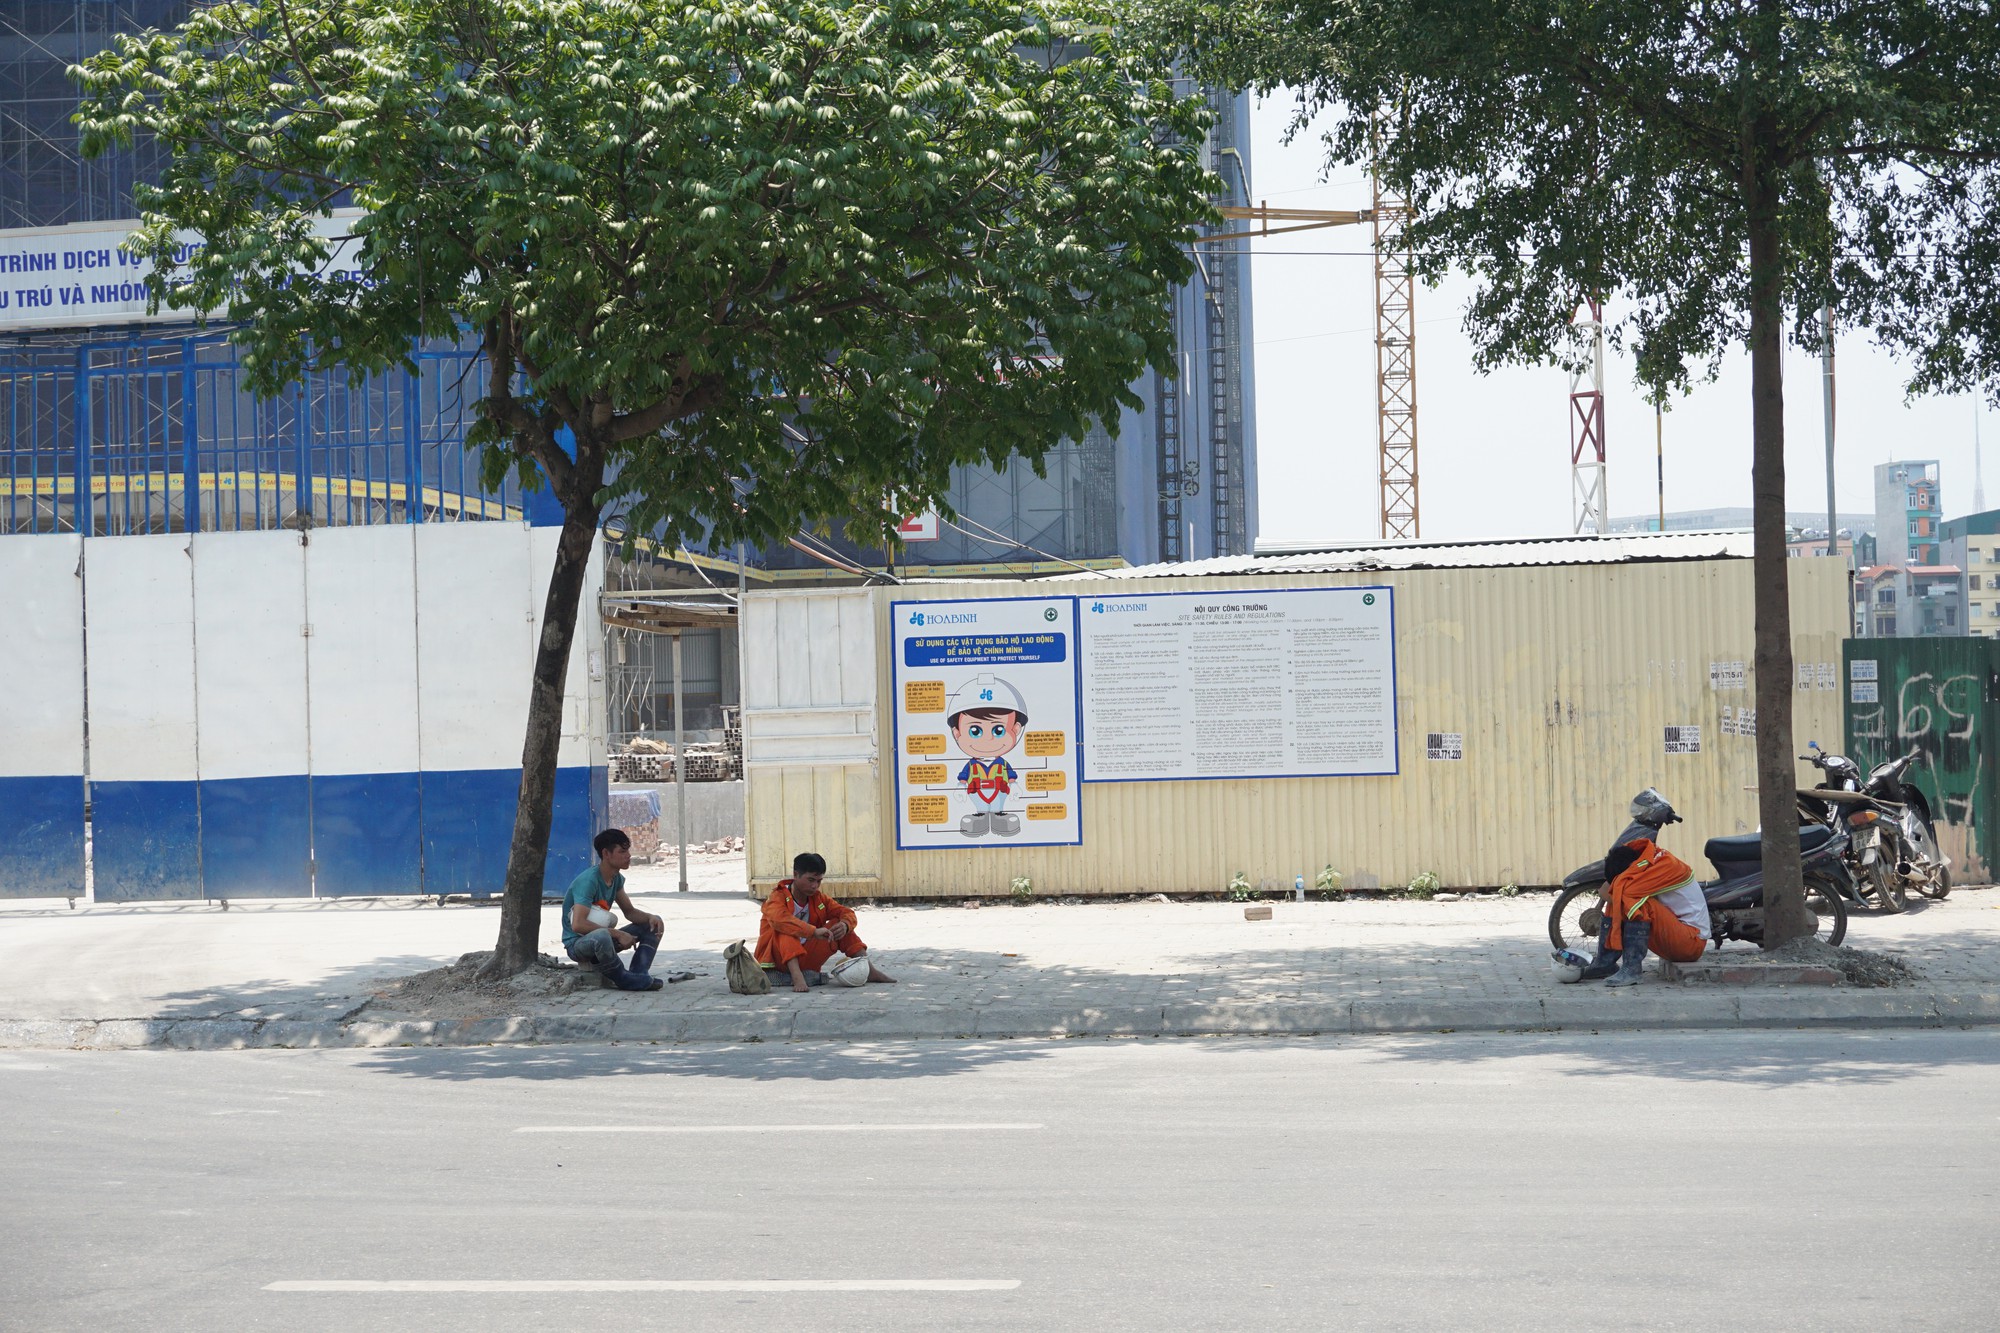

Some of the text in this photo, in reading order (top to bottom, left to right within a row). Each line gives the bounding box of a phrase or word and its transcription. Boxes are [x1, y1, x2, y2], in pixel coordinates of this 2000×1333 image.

[0, 251, 56, 273] TRÌNH
[64, 249, 110, 273] DỊCH
[116, 248, 142, 270] VỤ
[16, 285, 52, 308] TRÚ
[60, 283, 84, 305] VÀ
[92, 280, 150, 304] NHÓM
[961, 638, 973, 646] VẬT
[1011, 637, 1019, 645] HỘ
[1036, 636, 1054, 644] ĐỘNG
[973, 647, 981, 656] VỆ
[984, 646, 1003, 654] CHÍNH
[1006, 646, 1022, 654] MÌNH
[1665, 742, 1700, 752] 0968.771.220
[1428, 750, 1461, 759] 0968.771.220
